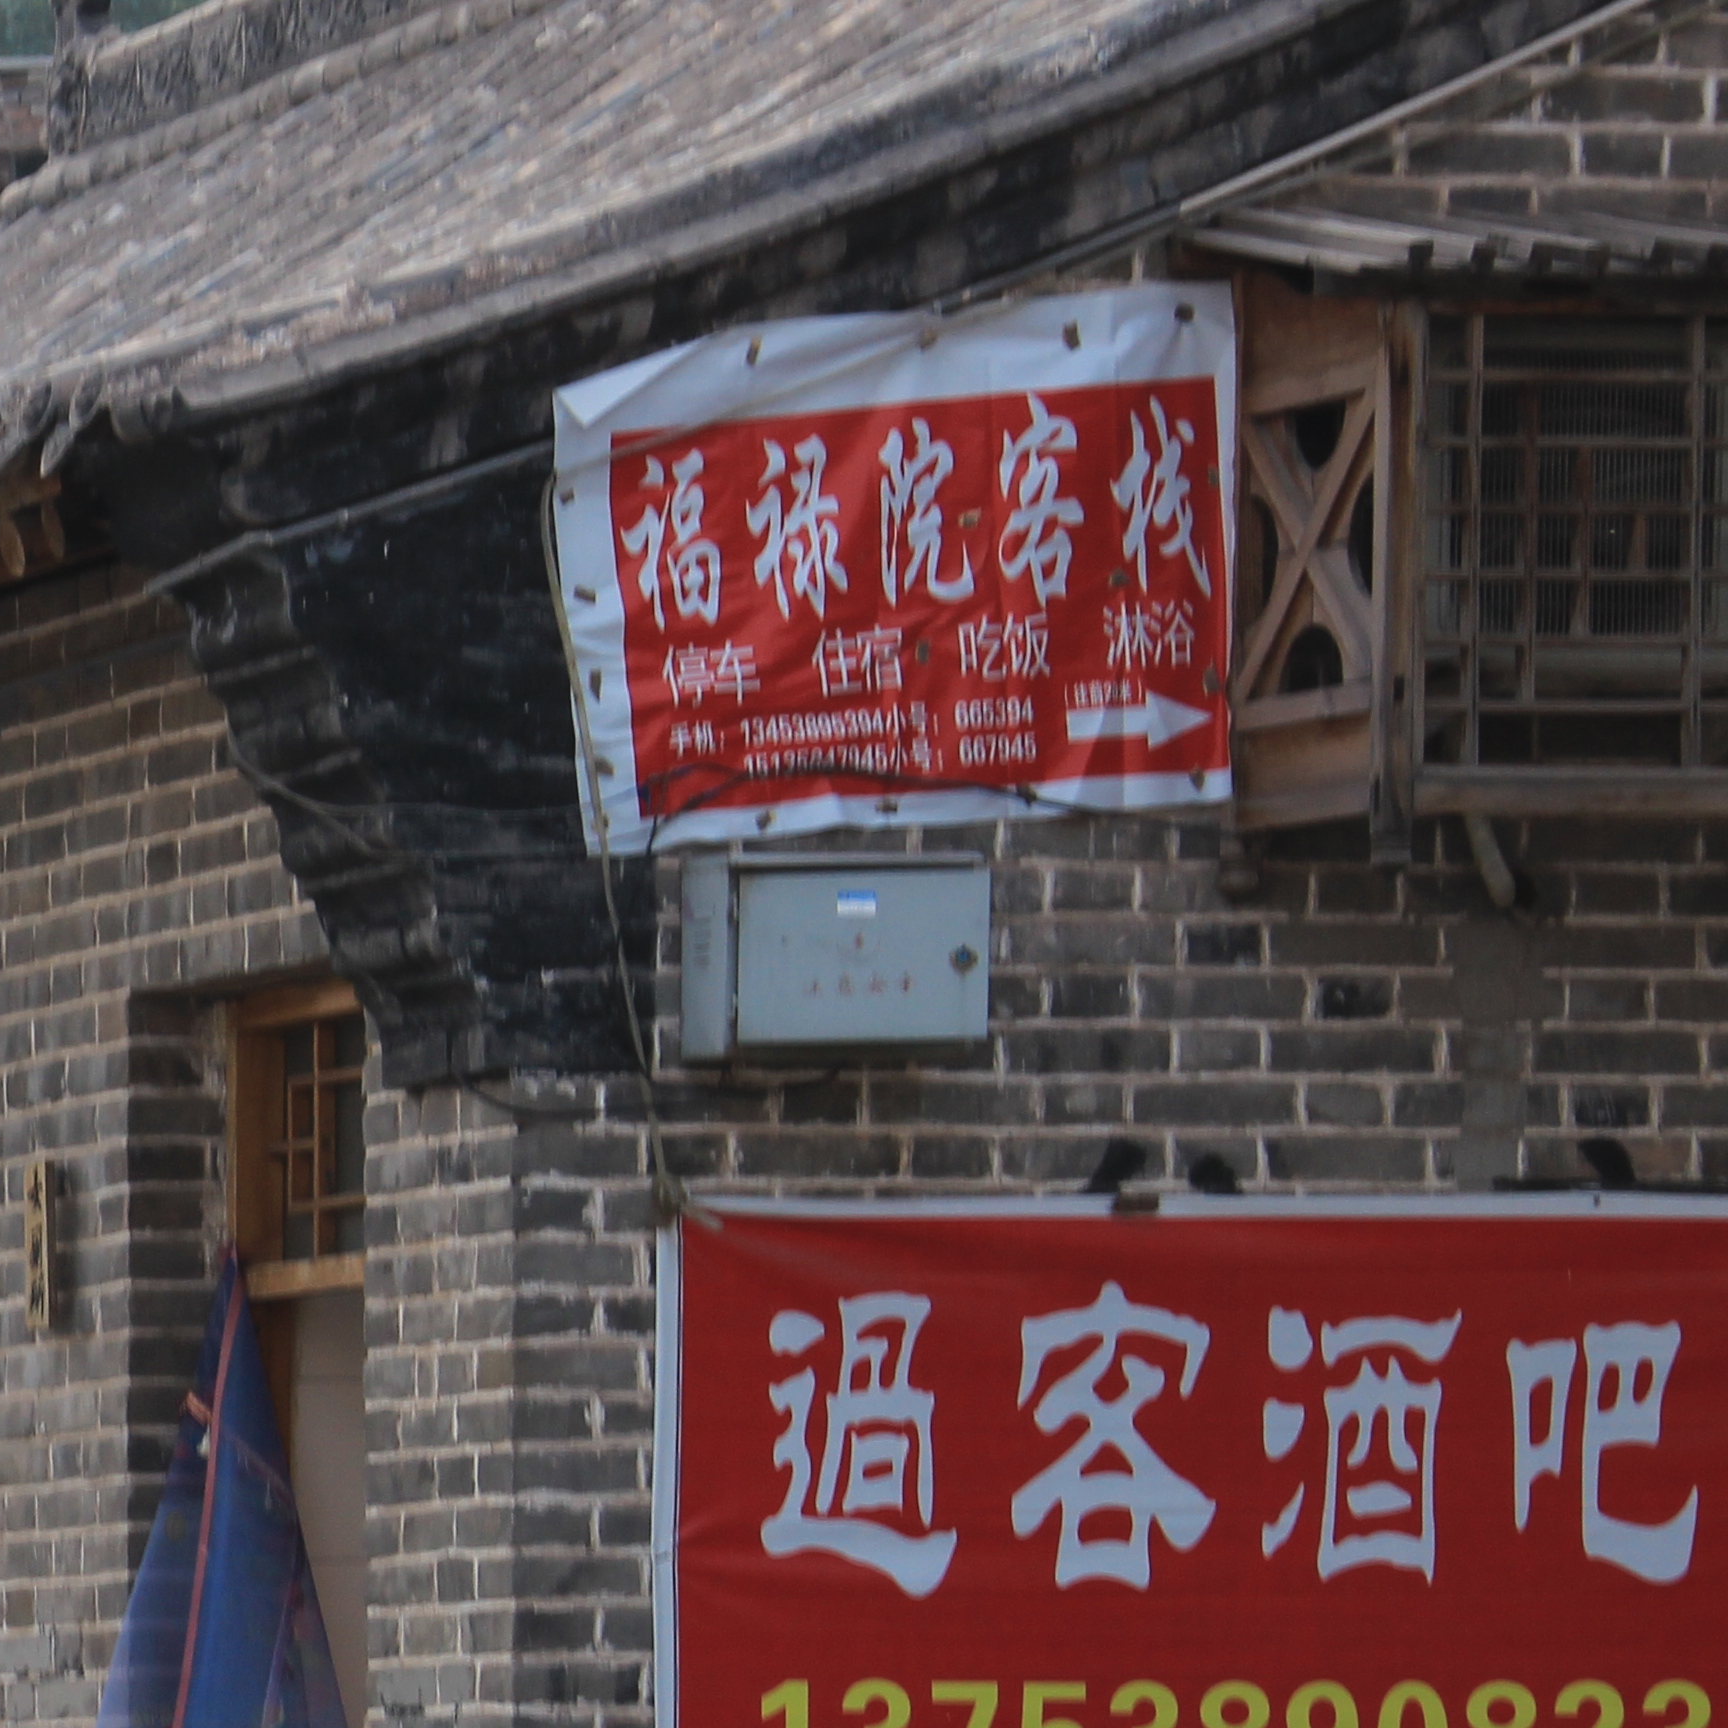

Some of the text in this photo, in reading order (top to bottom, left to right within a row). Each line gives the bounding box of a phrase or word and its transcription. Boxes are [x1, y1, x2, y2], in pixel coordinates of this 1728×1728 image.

[620, 390, 1212, 632] 福禄院客栈
[662, 599, 1195, 707] 停车 住宿 吃饭 淋浴
[760, 1280, 1699, 1599] 過客酒吧
